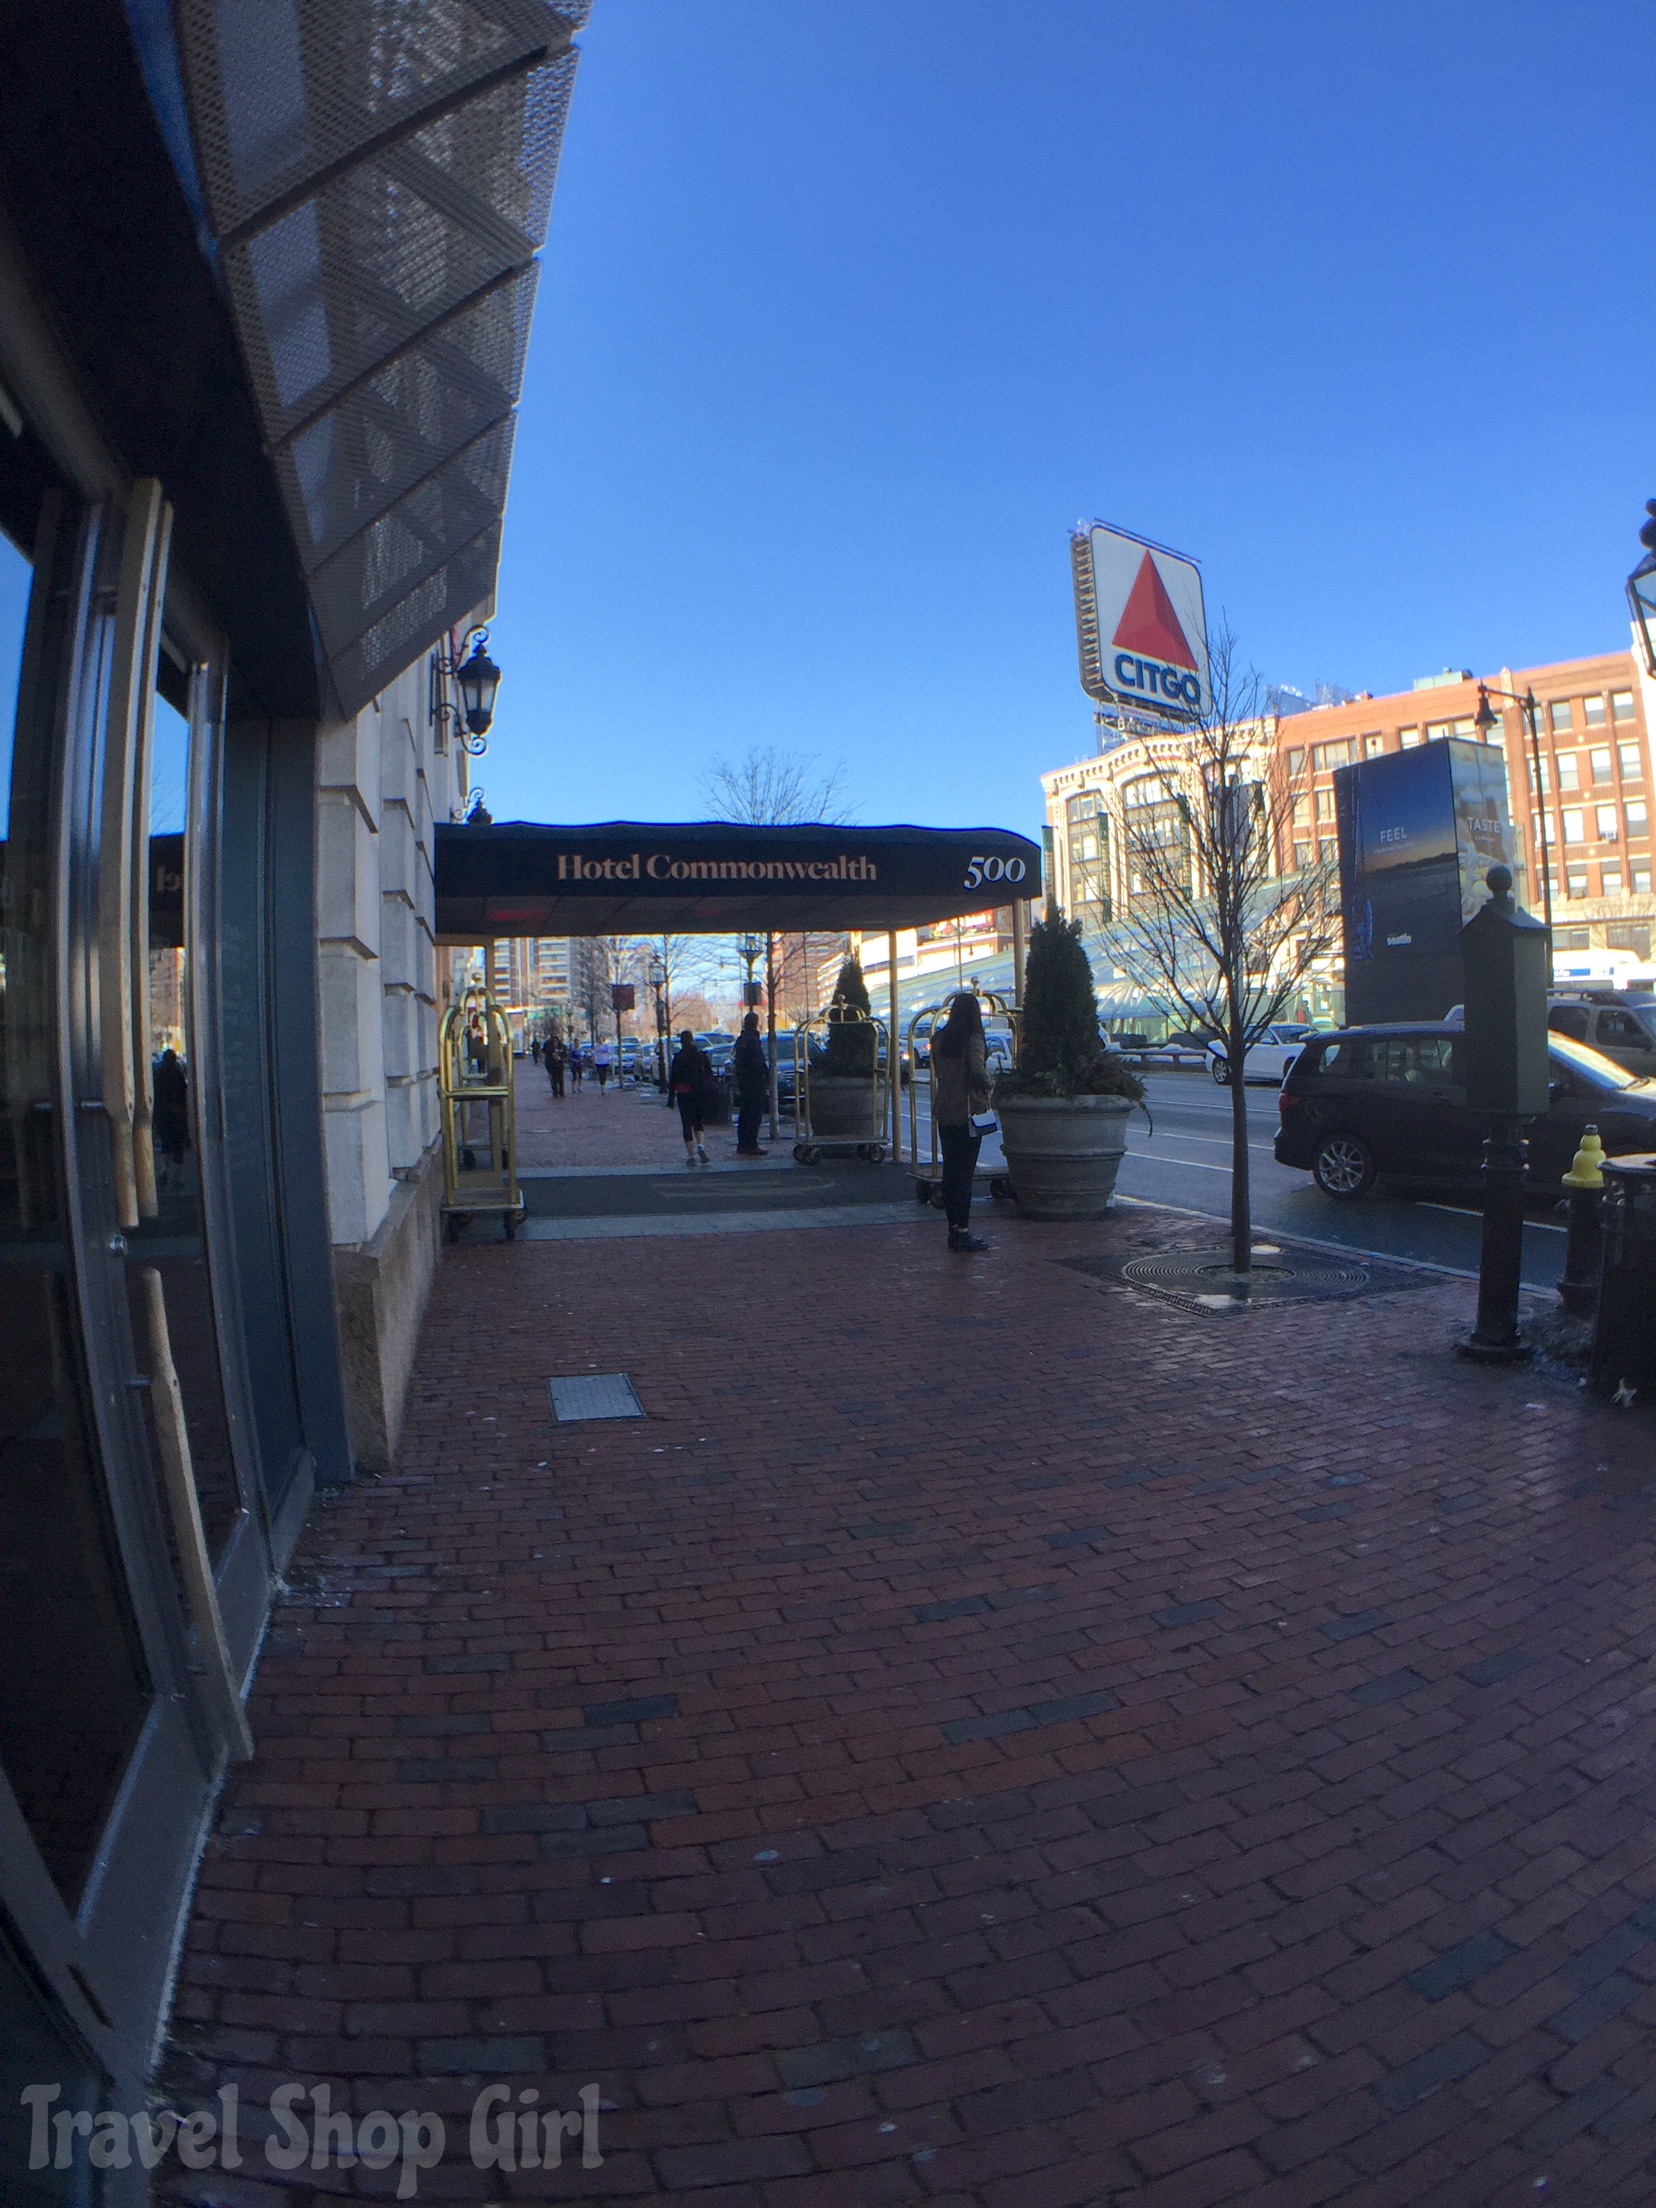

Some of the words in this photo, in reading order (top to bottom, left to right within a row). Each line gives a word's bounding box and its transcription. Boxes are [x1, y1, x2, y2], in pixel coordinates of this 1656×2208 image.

[1114, 653, 1202, 706] CITGO
[1380, 826, 1407, 843] FEEL
[1466, 816, 1500, 834] TASTE
[557, 853, 641, 880] Hotel
[646, 854, 877, 880] Commonwealth
[963, 856, 1026, 889] 500
